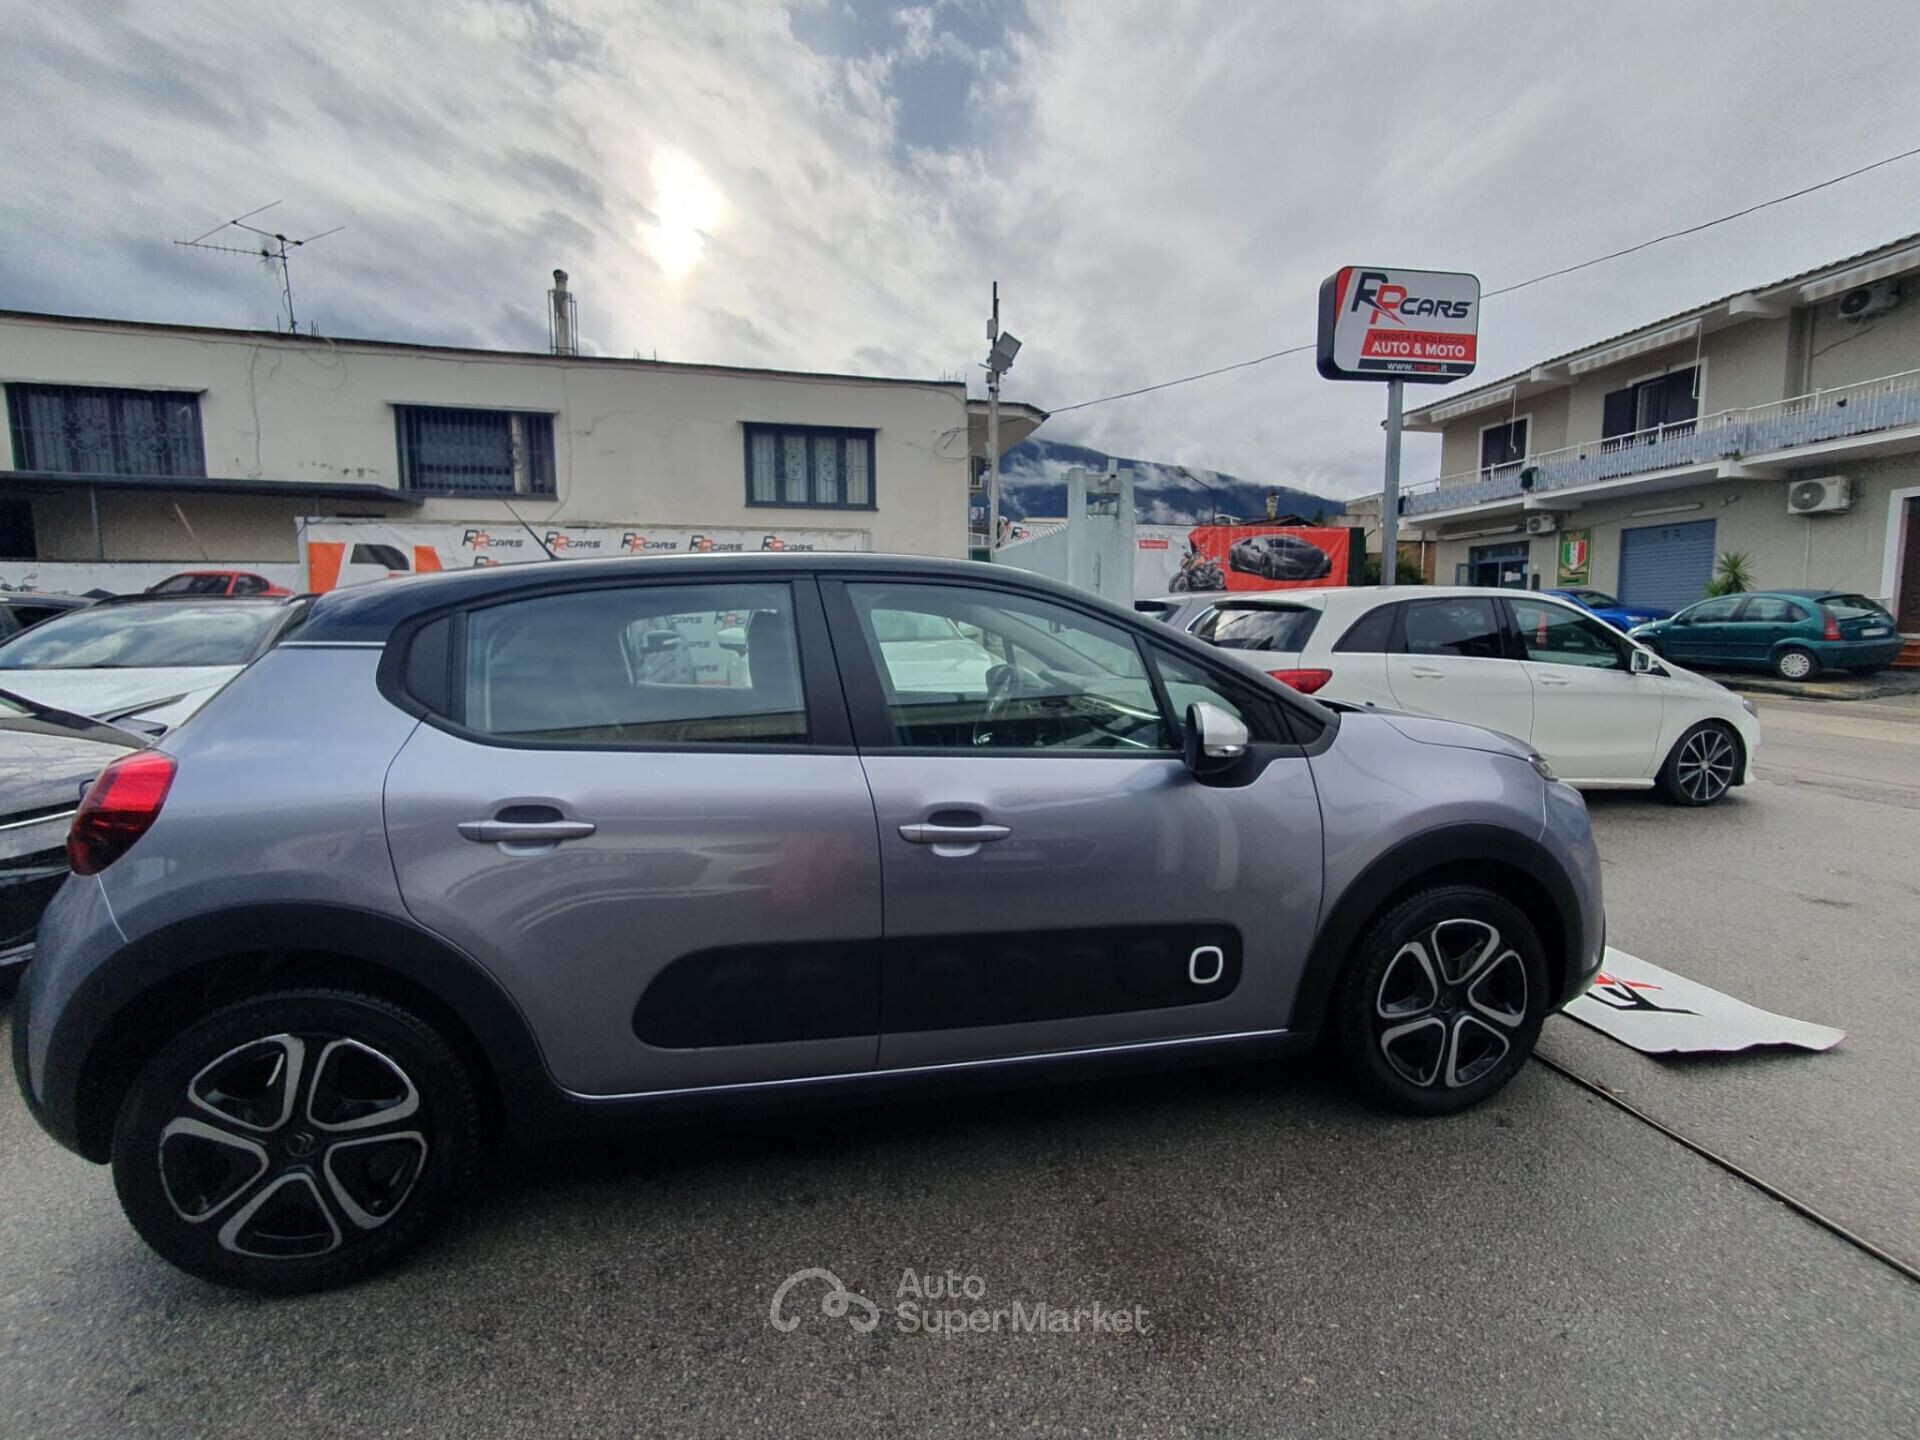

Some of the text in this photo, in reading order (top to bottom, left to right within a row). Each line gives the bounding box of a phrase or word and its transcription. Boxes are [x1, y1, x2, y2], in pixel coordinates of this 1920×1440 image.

[1371, 341, 1465, 357] AUTO & MOTO
